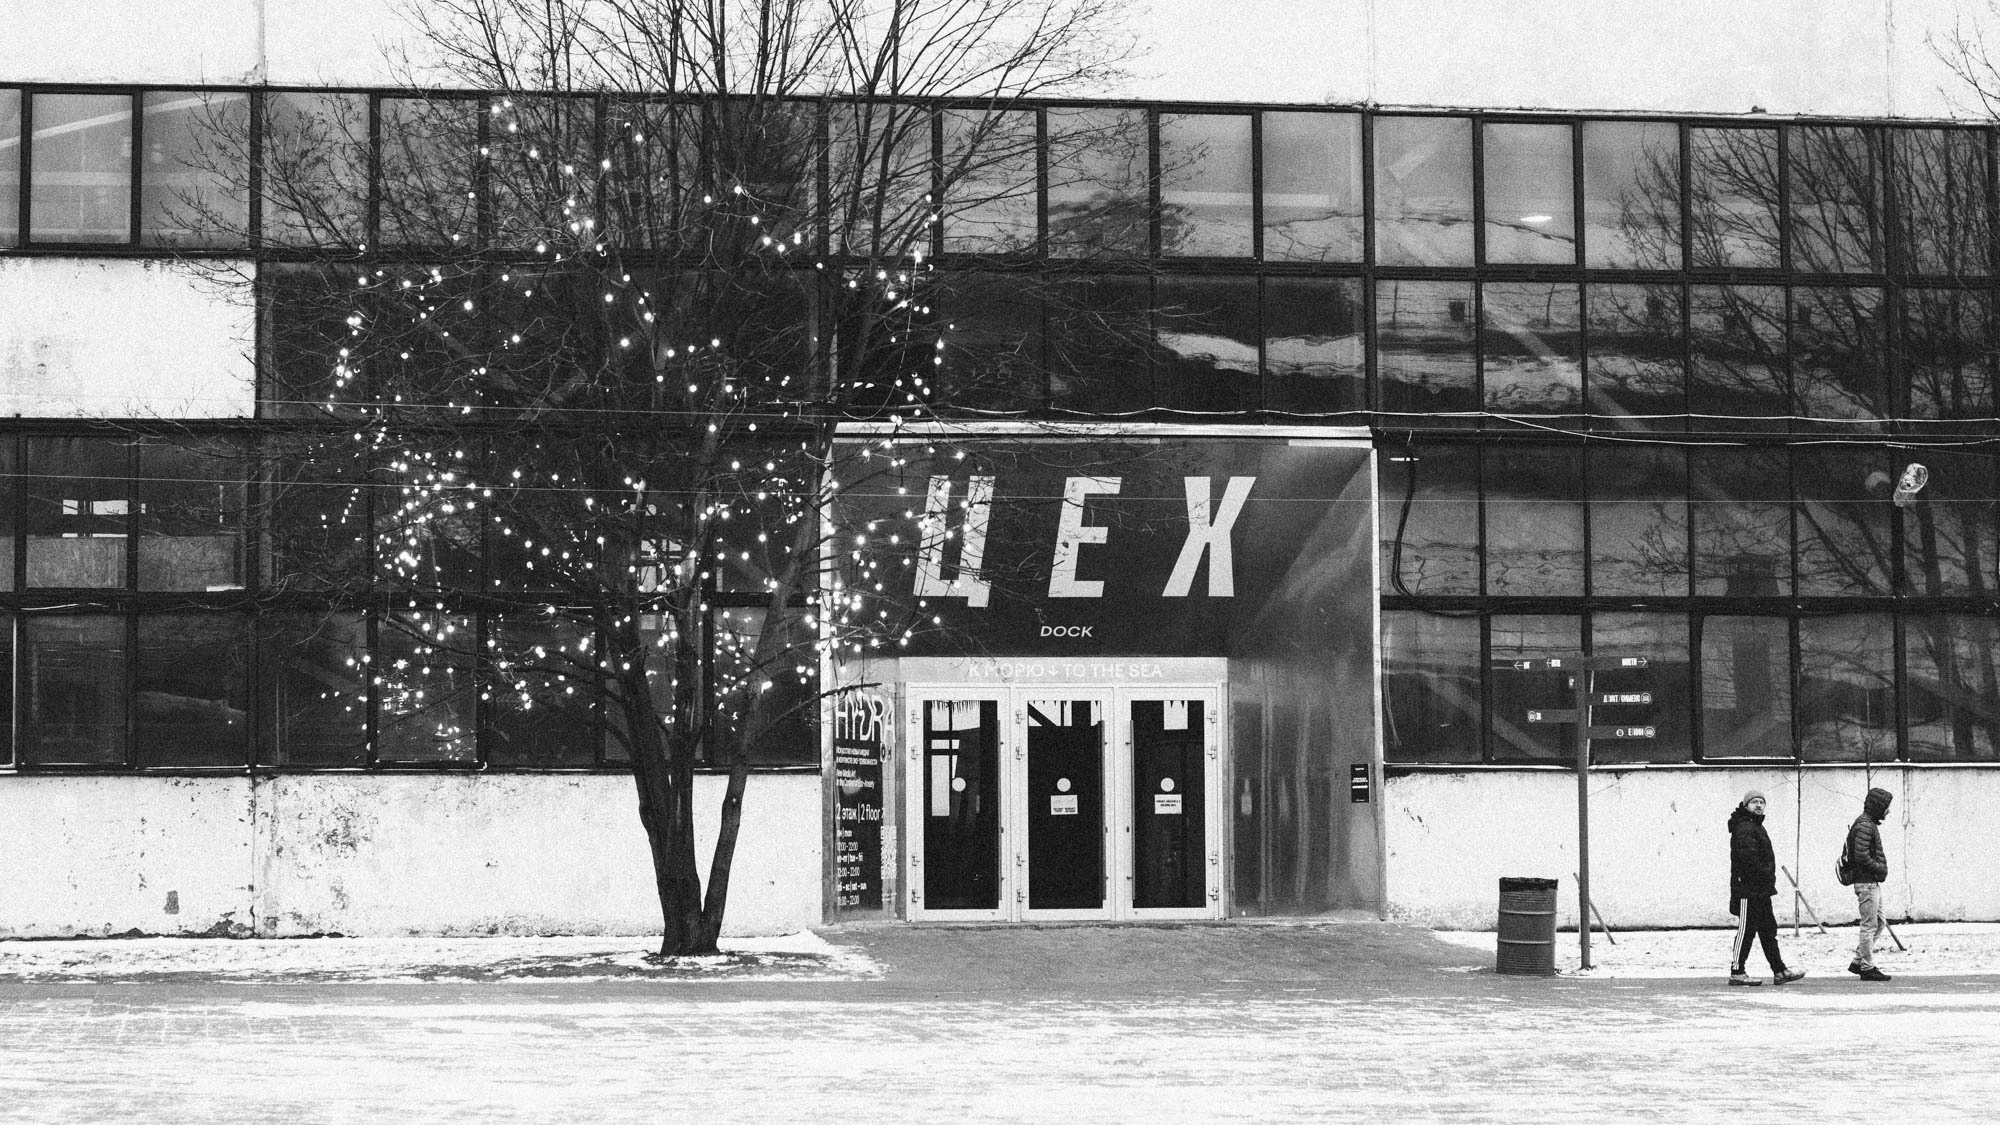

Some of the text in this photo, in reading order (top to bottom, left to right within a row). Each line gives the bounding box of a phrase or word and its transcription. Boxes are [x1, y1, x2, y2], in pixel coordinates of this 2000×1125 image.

[913, 475, 1257, 607] ЦЕХ
[1040, 626, 1093, 637] DOCK
[985, 663, 1044, 677] МОРЮ
[1064, 663, 1086, 677] TO
[1090, 663, 1125, 677] THE
[1129, 663, 1163, 677] SEA
[835, 691, 896, 743] HYDRA
[842, 808, 857, 820] этаж
[861, 803, 865, 821] 2
[866, 803, 880, 821] floor
